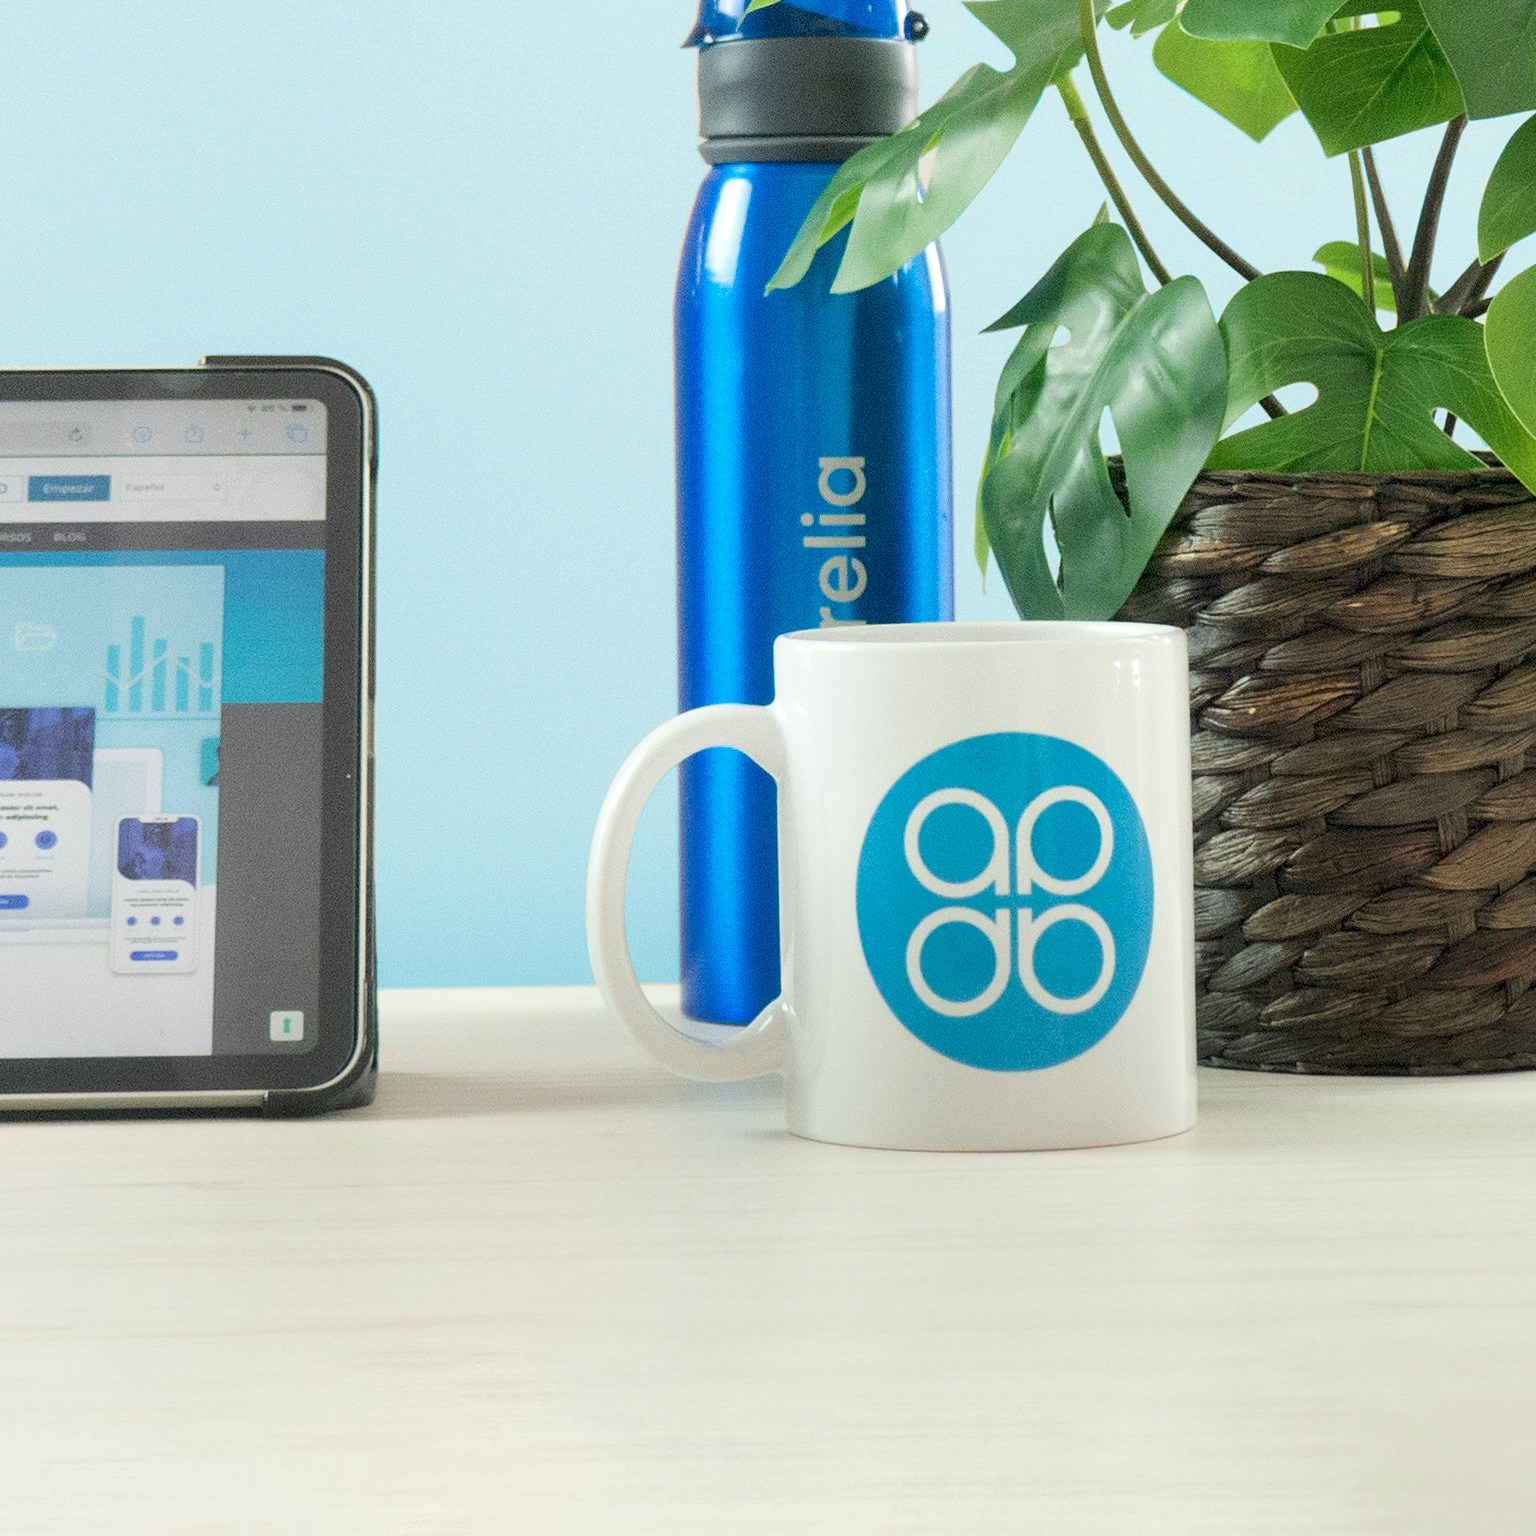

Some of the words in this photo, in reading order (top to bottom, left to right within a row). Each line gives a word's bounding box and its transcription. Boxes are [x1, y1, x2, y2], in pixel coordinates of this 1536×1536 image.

[42, 482, 95, 496] Empezar
[53, 531, 86, 542] BLOG
[800, 457, 868, 630] relia
